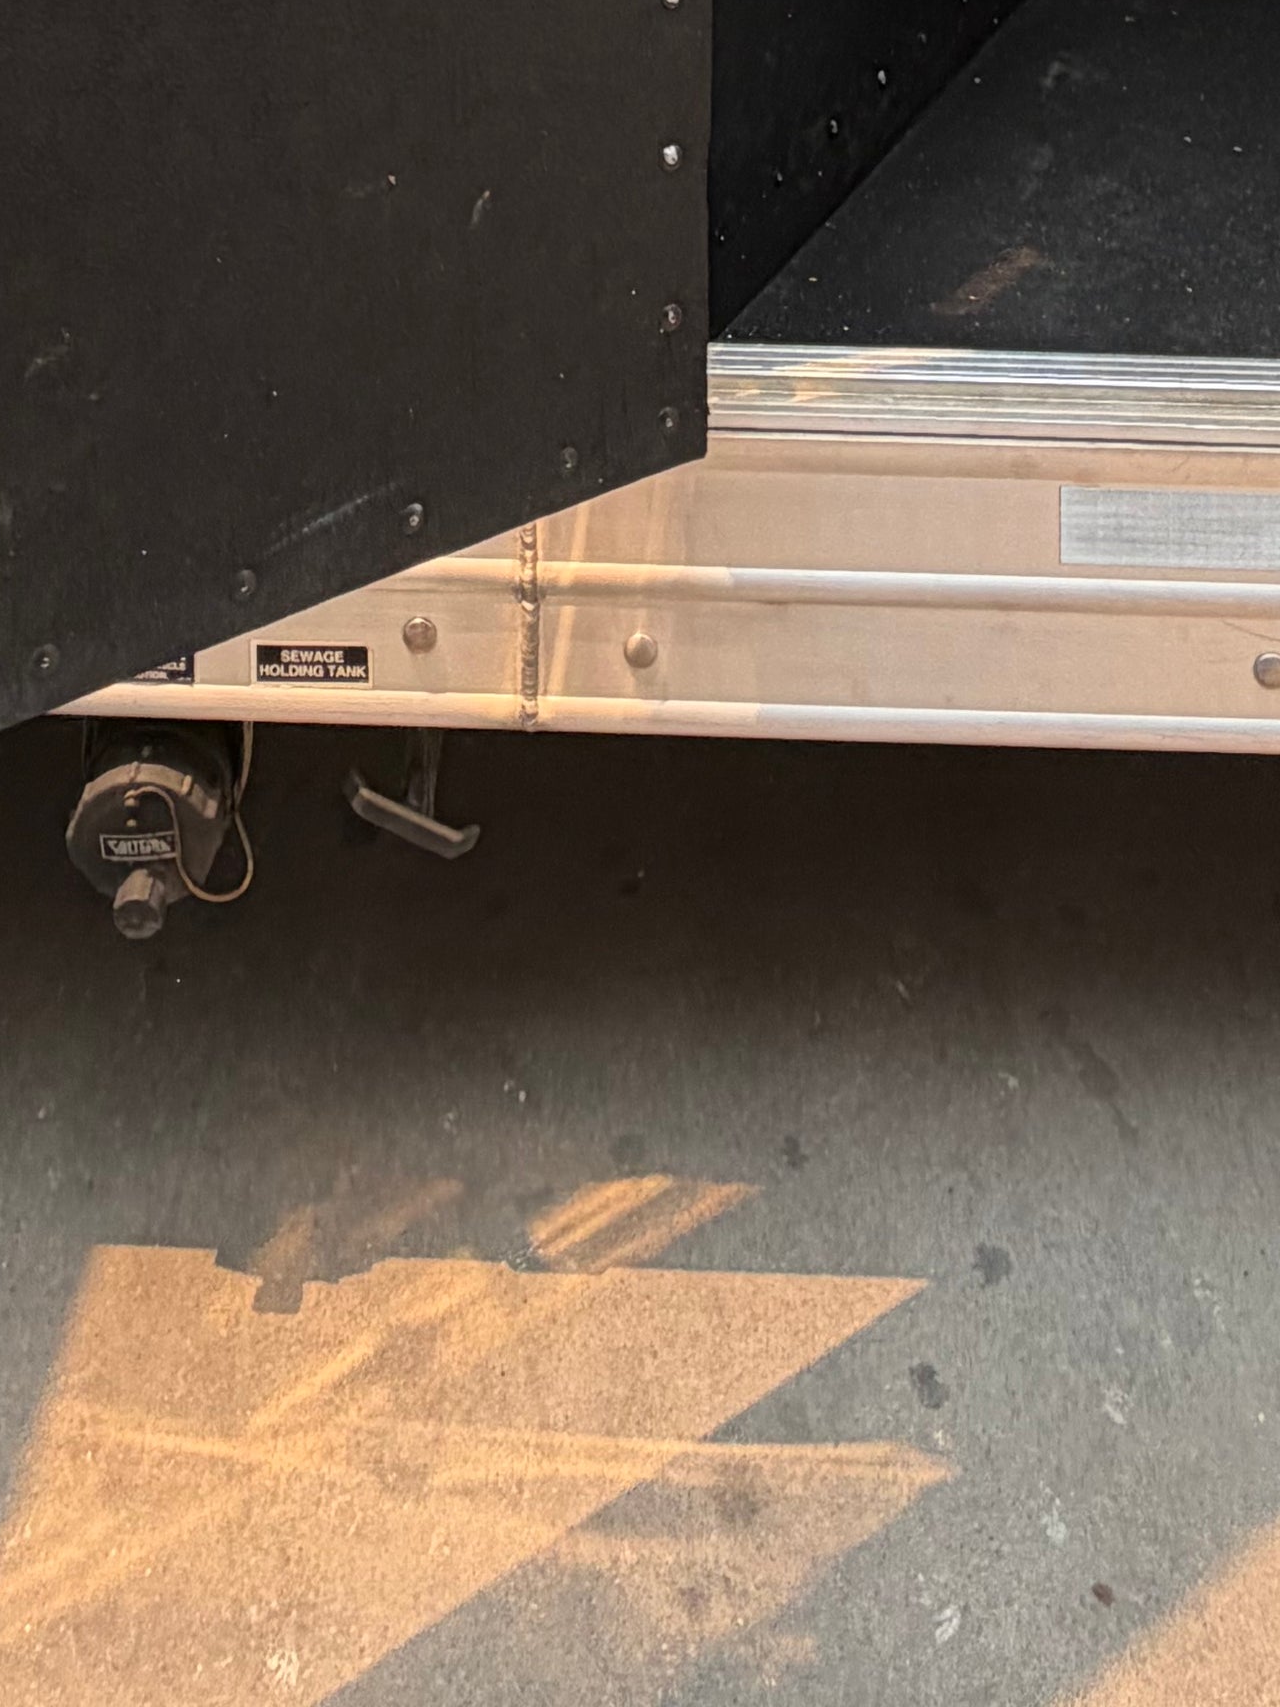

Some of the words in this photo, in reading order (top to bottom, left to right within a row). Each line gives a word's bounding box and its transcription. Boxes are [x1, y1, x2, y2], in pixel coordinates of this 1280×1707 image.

[280, 650, 345, 664] SEWAGE
[259, 664, 325, 678] HOLDING
[327, 666, 367, 678] TANK
